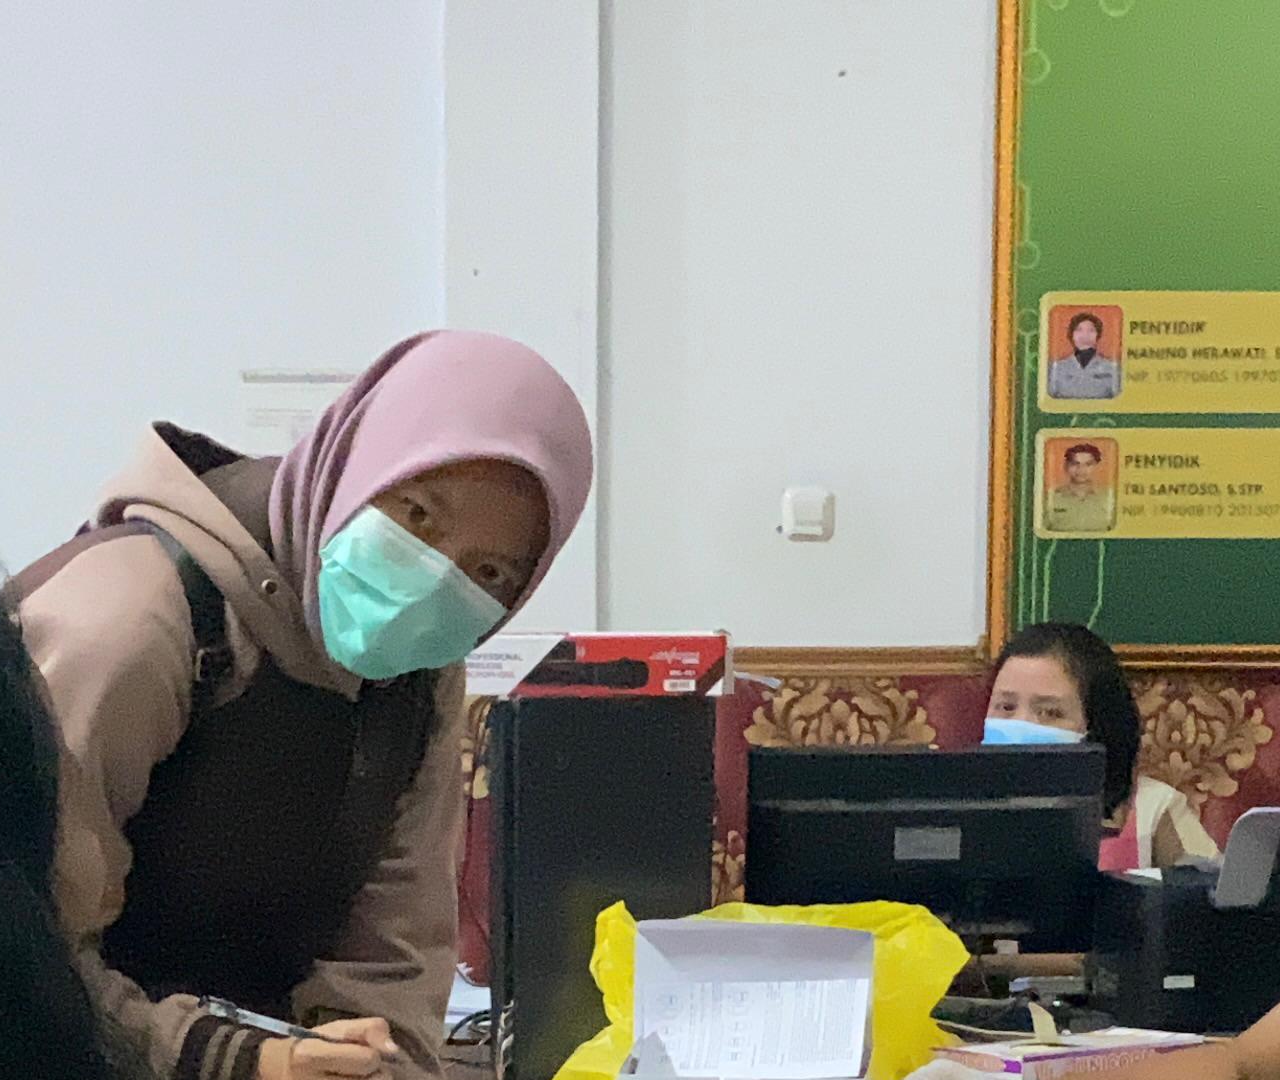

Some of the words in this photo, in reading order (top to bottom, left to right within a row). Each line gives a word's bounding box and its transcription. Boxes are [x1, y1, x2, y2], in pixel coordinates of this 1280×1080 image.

[1129, 320, 1206, 335] PENYIDIK
[1127, 347, 1187, 360] NANING
[1124, 454, 1201, 468] PENYIDIK
